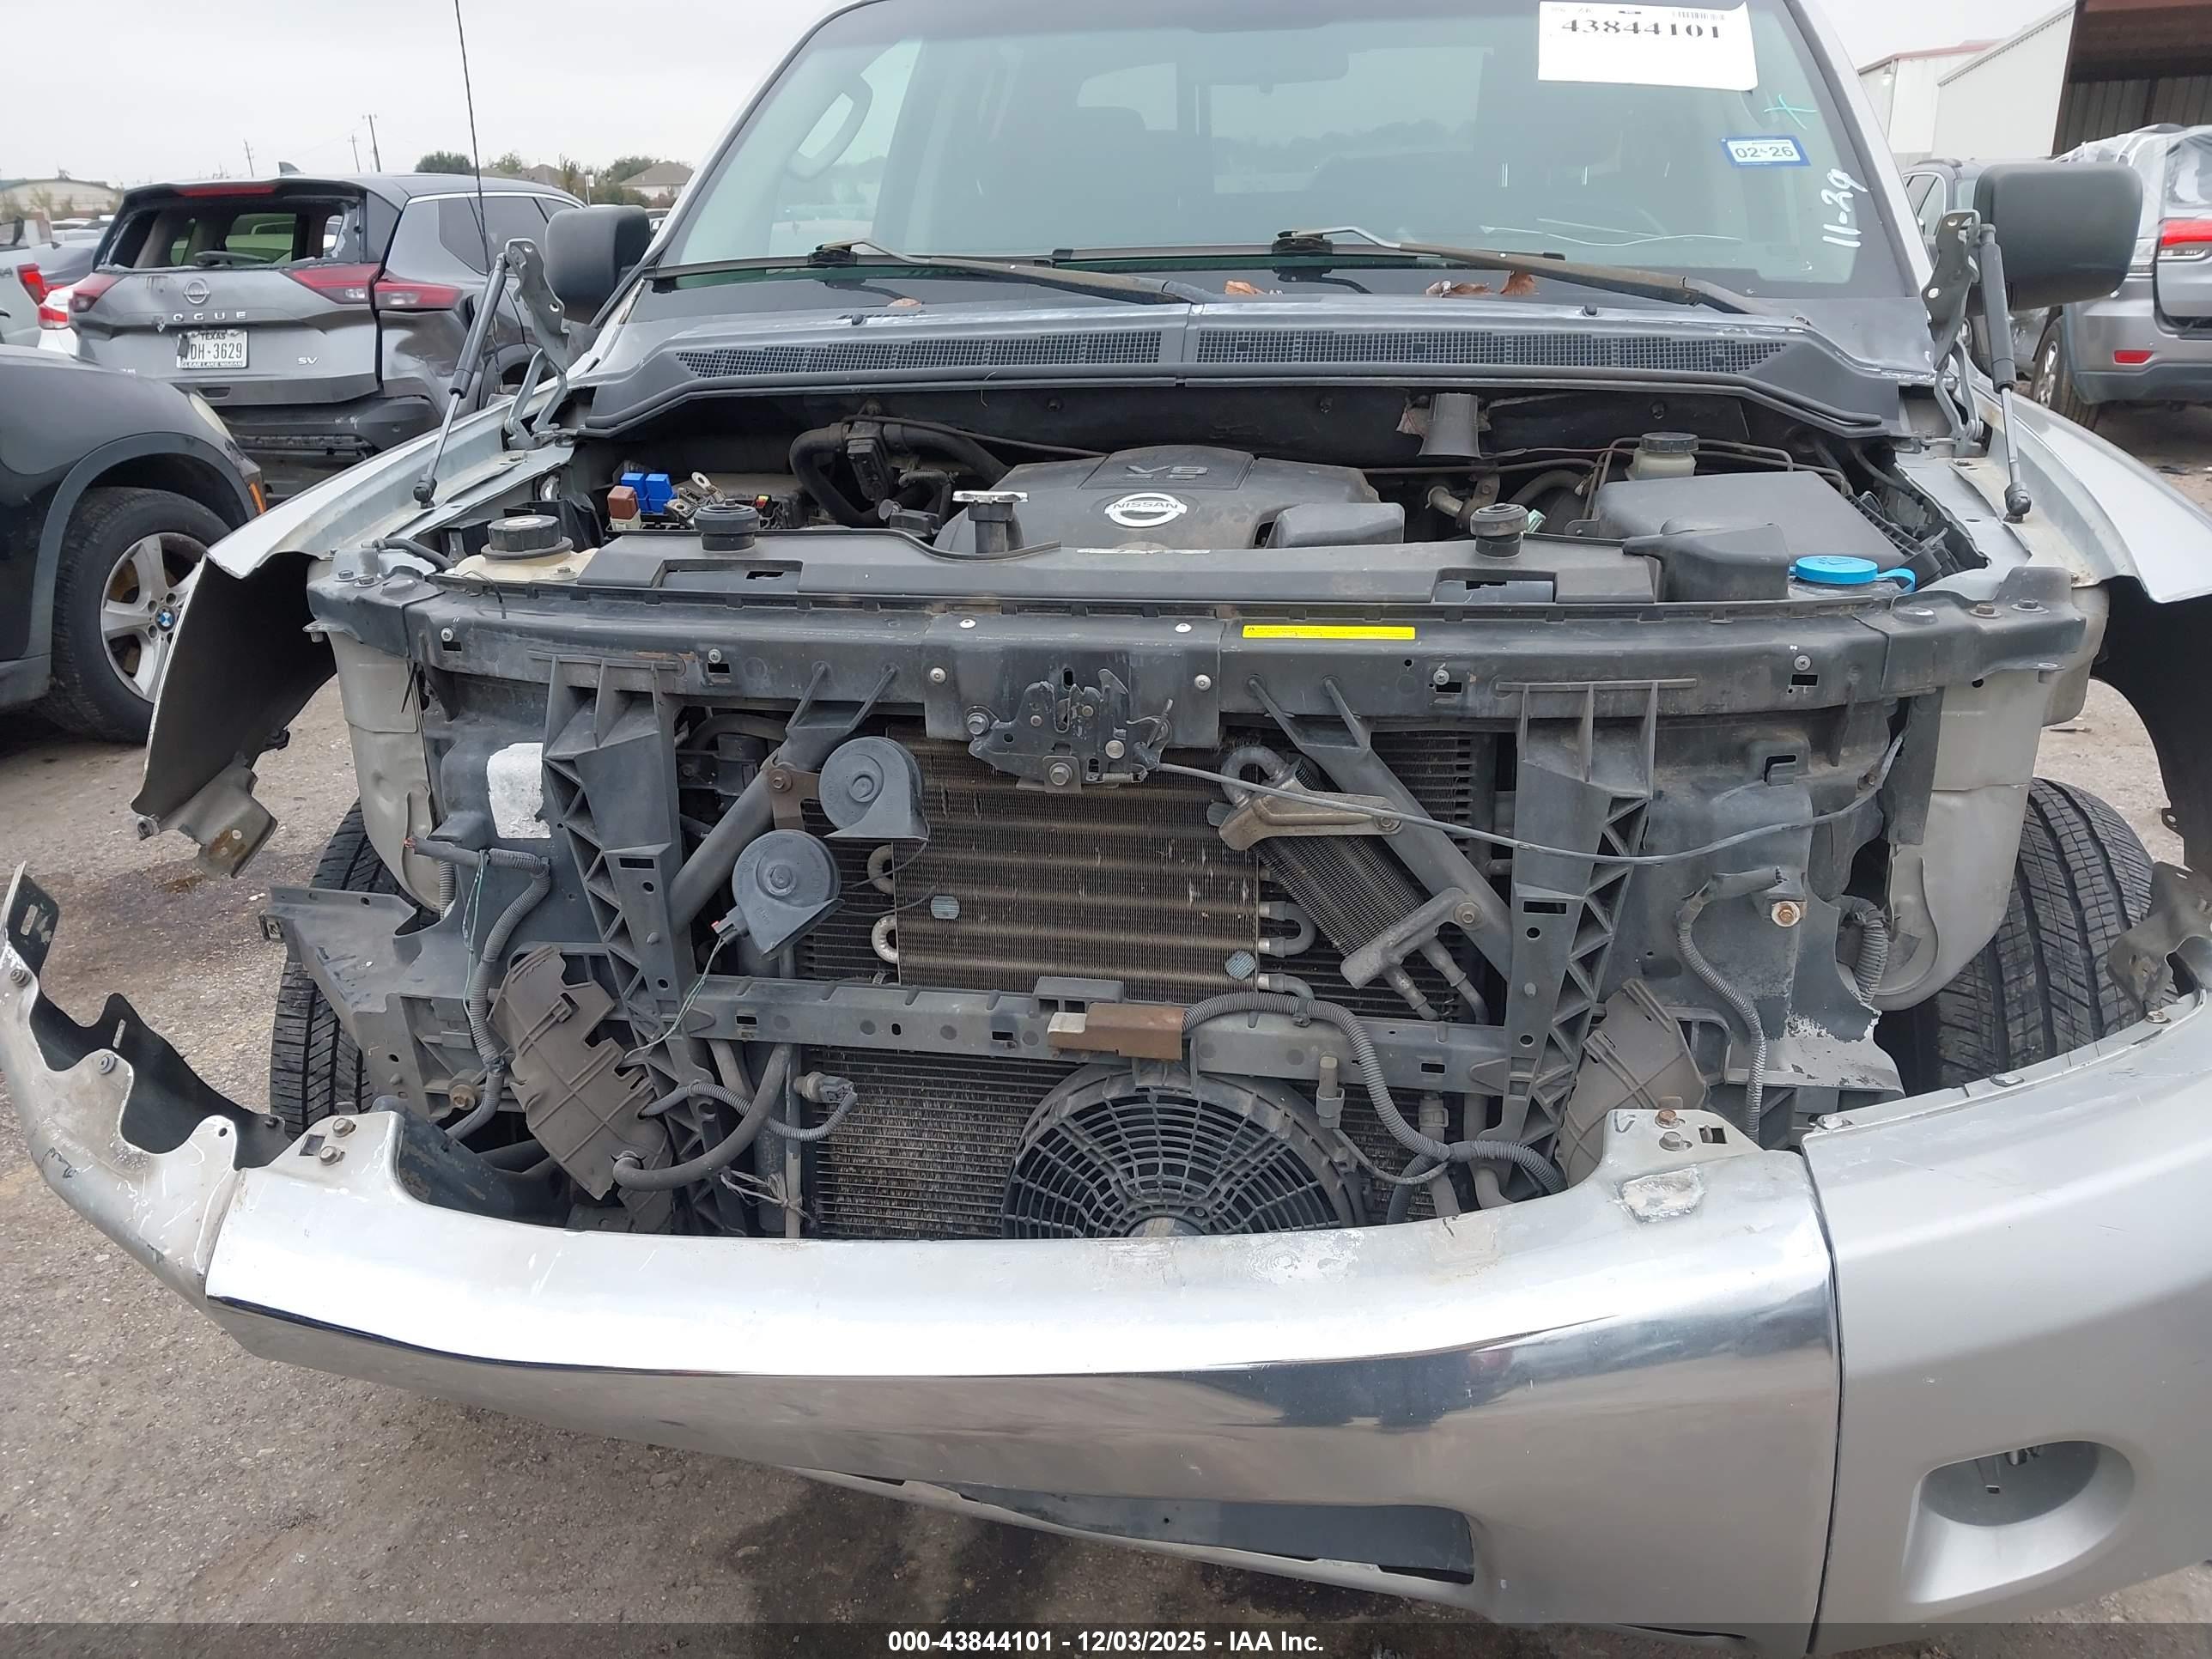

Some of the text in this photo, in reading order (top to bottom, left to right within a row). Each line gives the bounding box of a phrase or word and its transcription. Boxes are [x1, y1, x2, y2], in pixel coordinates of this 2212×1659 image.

[1561, 19, 1720, 38] 43844101
[298, 356, 318, 365] SV
[1112, 501, 1179, 509] NISSAN
